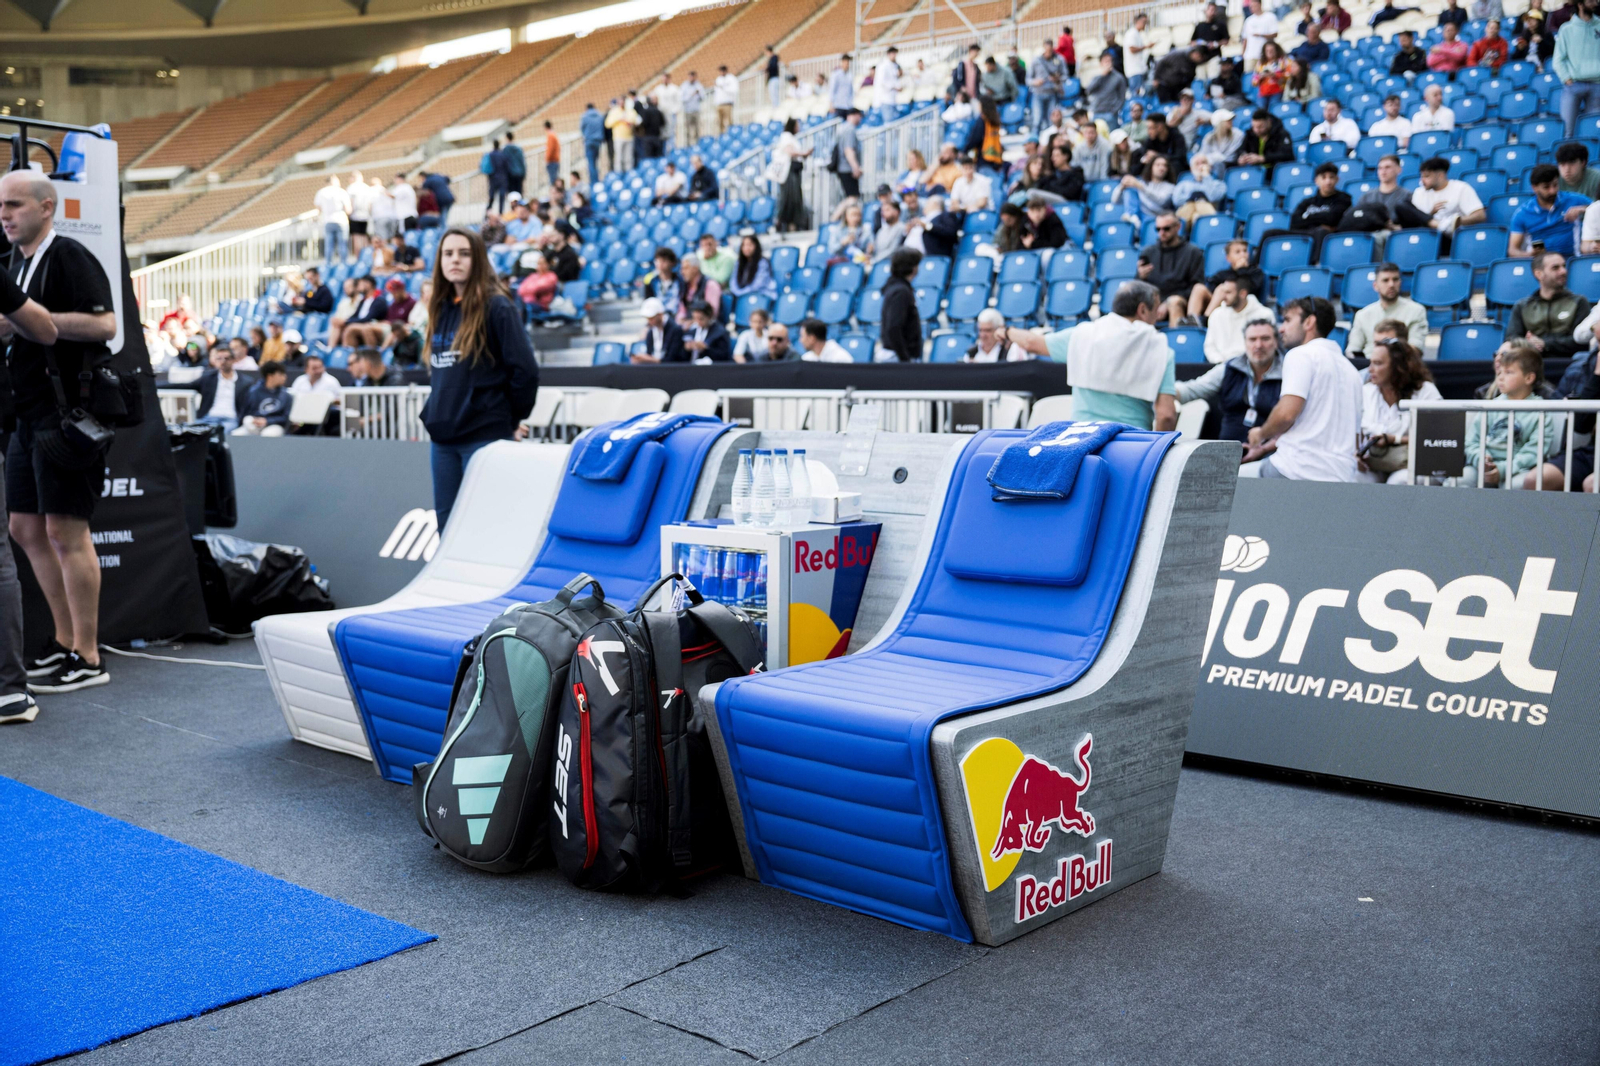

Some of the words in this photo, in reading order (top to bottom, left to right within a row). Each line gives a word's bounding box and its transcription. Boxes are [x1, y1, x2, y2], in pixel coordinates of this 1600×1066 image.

[1423, 439, 1458, 448] PLAYERS
[794, 535, 839, 573] Red
[1207, 664, 1326, 698] PREMIUM
[1327, 679, 1419, 710] PADEL
[1426, 691, 1549, 726] COURTS
[554, 723, 572, 839] SET
[1015, 858, 1068, 922] Red
[1069, 840, 1112, 900] Bull
